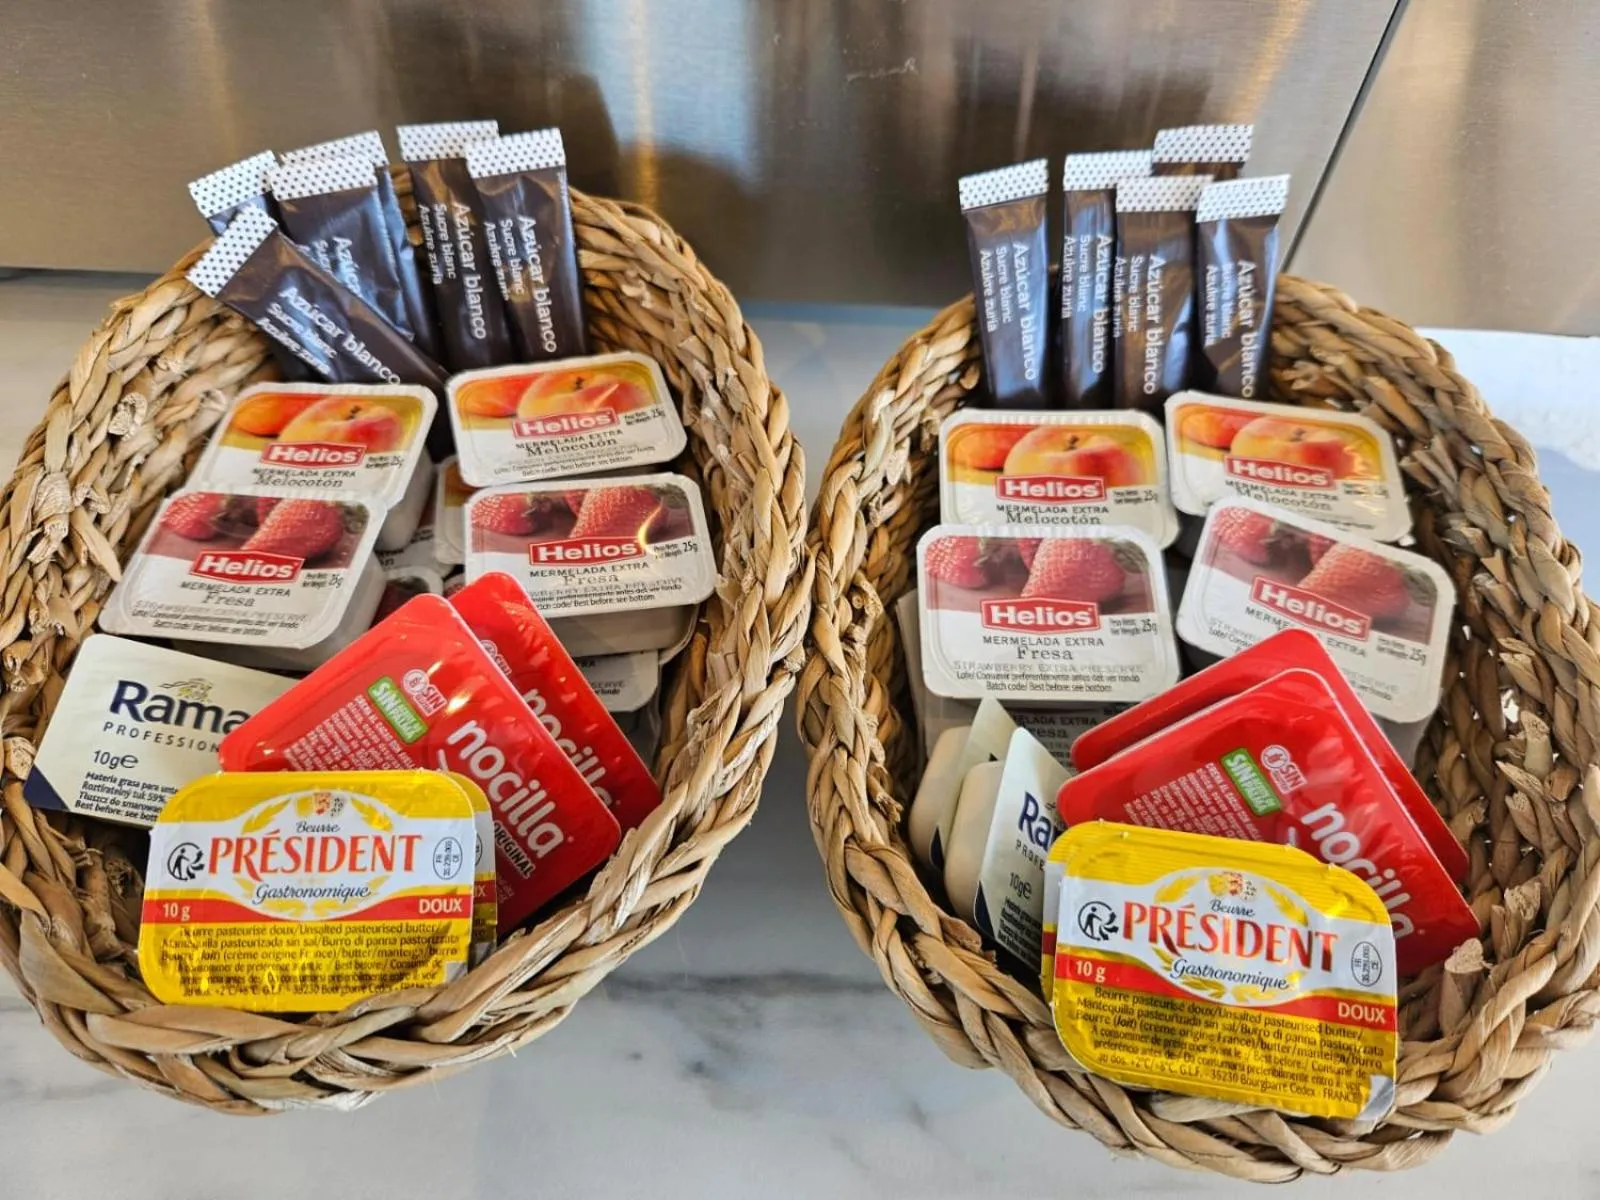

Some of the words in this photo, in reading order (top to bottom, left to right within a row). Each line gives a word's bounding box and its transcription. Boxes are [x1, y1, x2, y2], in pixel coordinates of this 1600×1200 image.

[433, 203, 449, 241] Sucre
[451, 201, 476, 270] Azúcar
[500, 218, 517, 256] Sucre
[332, 236, 362, 295] Azúca
[440, 242, 457, 279] blanc
[1095, 233, 1113, 302] Azúcar
[517, 215, 544, 287] Azúcar
[533, 288, 557, 353] blanco
[1012, 243, 1031, 310] Azúcar
[1145, 254, 1167, 323] Azúcar
[1237, 260, 1257, 327] Azúcar
[463, 275, 487, 340] blanco
[279, 286, 345, 338] Azúcar
[342, 331, 401, 385] blanco
[1092, 308, 1109, 374] blanco
[1020, 314, 1037, 381] blanco
[1143, 328, 1165, 395] blanco
[1240, 331, 1258, 398] blanco
[519, 413, 612, 437] Helios
[515, 435, 586, 450] MERMELADA
[588, 429, 624, 442] EXTRA
[526, 438, 618, 457] Melocotón
[268, 445, 358, 465] Helios
[252, 468, 319, 478] MERMELADA
[321, 469, 356, 478] EXTRA
[253, 476, 343, 488] Melocotón
[1232, 459, 1329, 487] Helios
[1004, 479, 1099, 498] Helios
[1225, 478, 1297, 497] MERMELADA
[1300, 491, 1339, 502] EXTRA
[996, 504, 1067, 514] MERMELADA
[1072, 505, 1109, 514] EXTRA
[1006, 512, 1102, 525] Melocotón
[538, 542, 637, 561] Helios
[200, 555, 293, 580] Helios
[529, 565, 609, 578] MERMELADA
[611, 561, 649, 571] EXTRA
[179, 580, 252, 594] MERMELADA
[255, 586, 292, 597] EXTRA
[562, 574, 620, 586] Fresa
[202, 591, 255, 607] Fresa
[1260, 584, 1364, 636] Helios
[990, 605, 1093, 626] Helios
[982, 635, 1060, 646] MERMELADA
[1064, 637, 1105, 647] EXTRA
[1327, 637, 1367, 658] EXTRA
[1017, 646, 1074, 661] Fresa
[109, 679, 251, 736] Rama
[102, 720, 221, 753] PROFESSION
[85, 771, 120, 785] Materia
[120, 777, 141, 790] grasa
[141, 780, 160, 793] para
[447, 719, 565, 859] nocilla
[74, 800, 94, 811] Best
[125, 809, 140, 818] see
[109, 796, 121, 806] do
[295, 820, 341, 834] Beurre
[207, 829, 423, 882] PRÉSIDENT
[252, 882, 372, 906] Gastronomique
[162, 902, 178, 918] 10
[181, 905, 191, 921] g
[418, 898, 463, 914] DOUX
[1209, 899, 1256, 917] Beurre
[345, 922, 402, 935] pasteurised
[1122, 902, 1339, 973] PRÉSIDENT
[365, 936, 397, 948] panna
[1075, 961, 1093, 977] 10
[1095, 967, 1107, 984] g
[1169, 958, 1290, 991] Gastronomique
[1337, 1001, 1387, 1024] DOUX
[1285, 1032, 1317, 1047] panna
